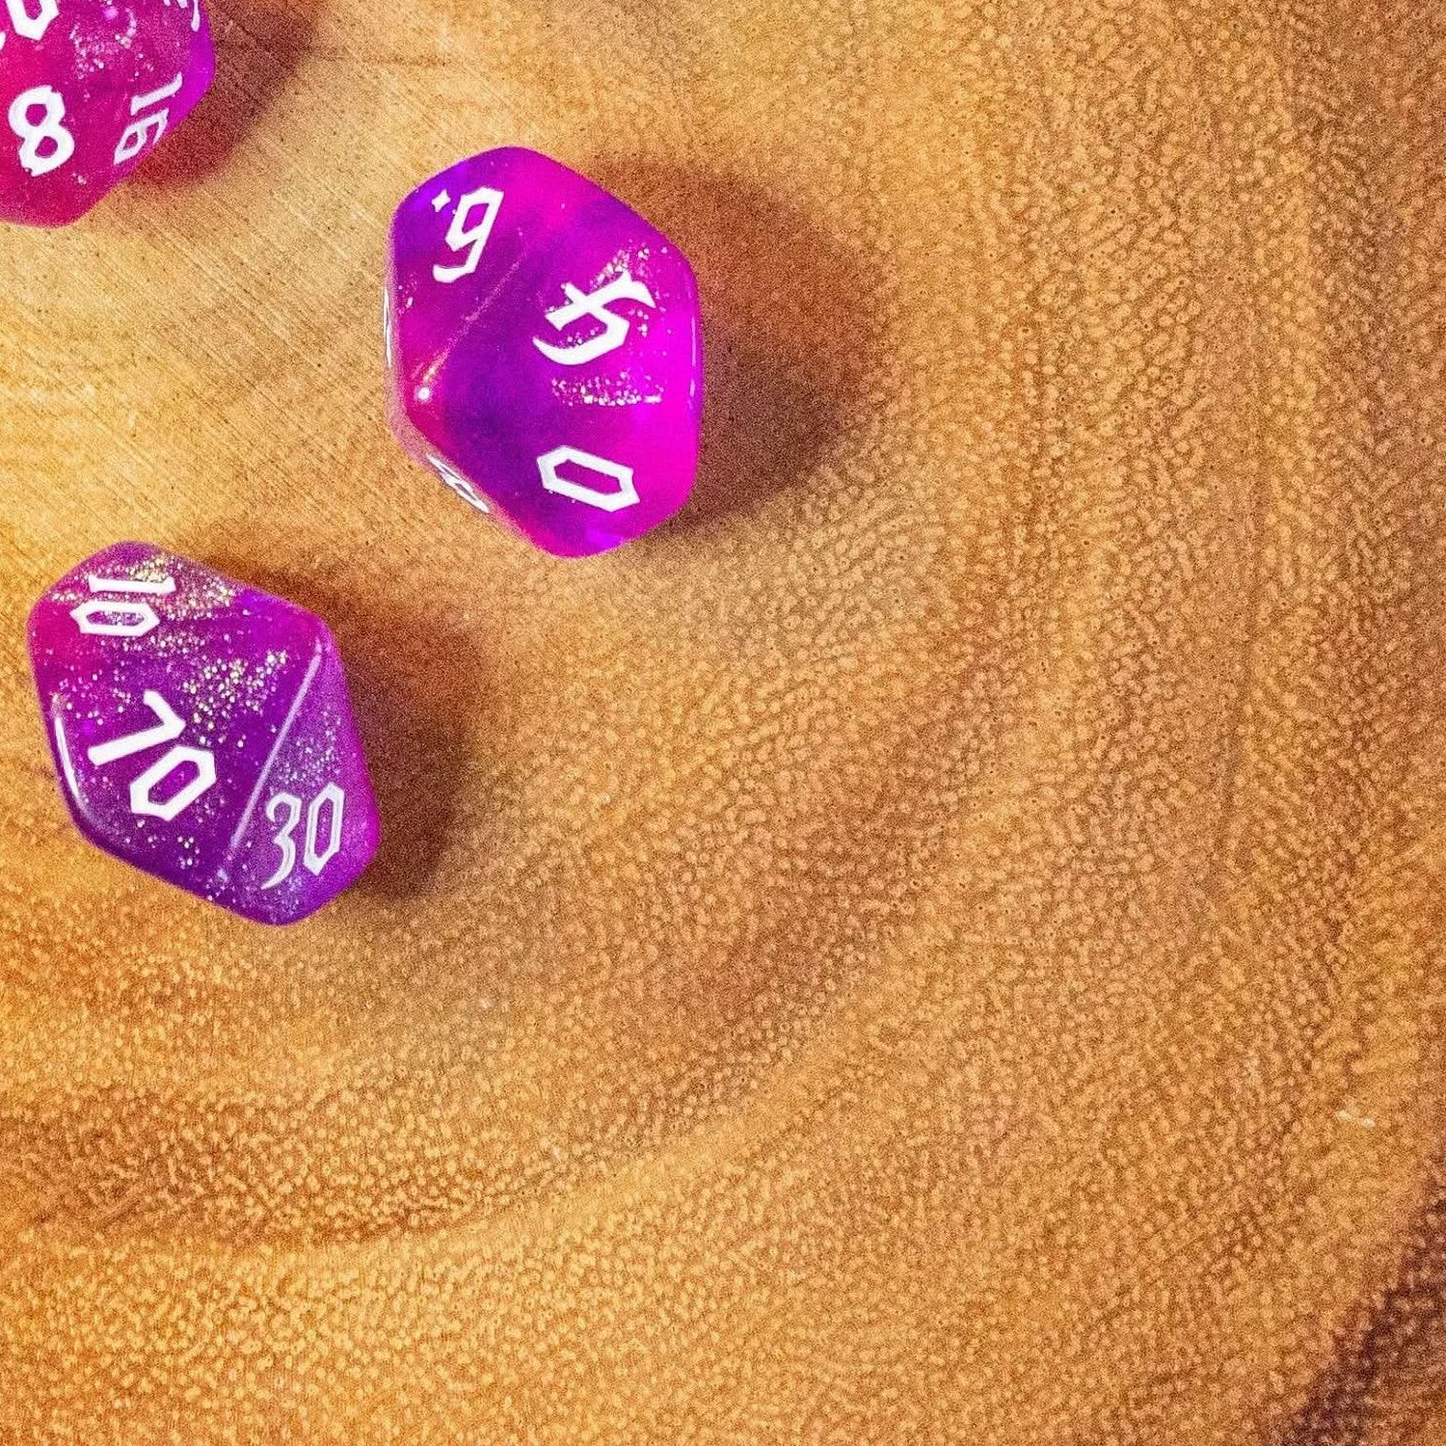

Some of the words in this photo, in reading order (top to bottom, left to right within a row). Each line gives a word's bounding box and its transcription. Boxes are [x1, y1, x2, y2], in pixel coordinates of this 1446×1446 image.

[8, 85, 76, 177] 8
[532, 270, 656, 366] 4
[536, 445, 640, 513] 0
[69, 574, 176, 637] 10
[86, 689, 217, 822] 70
[260, 781, 346, 890] 30
